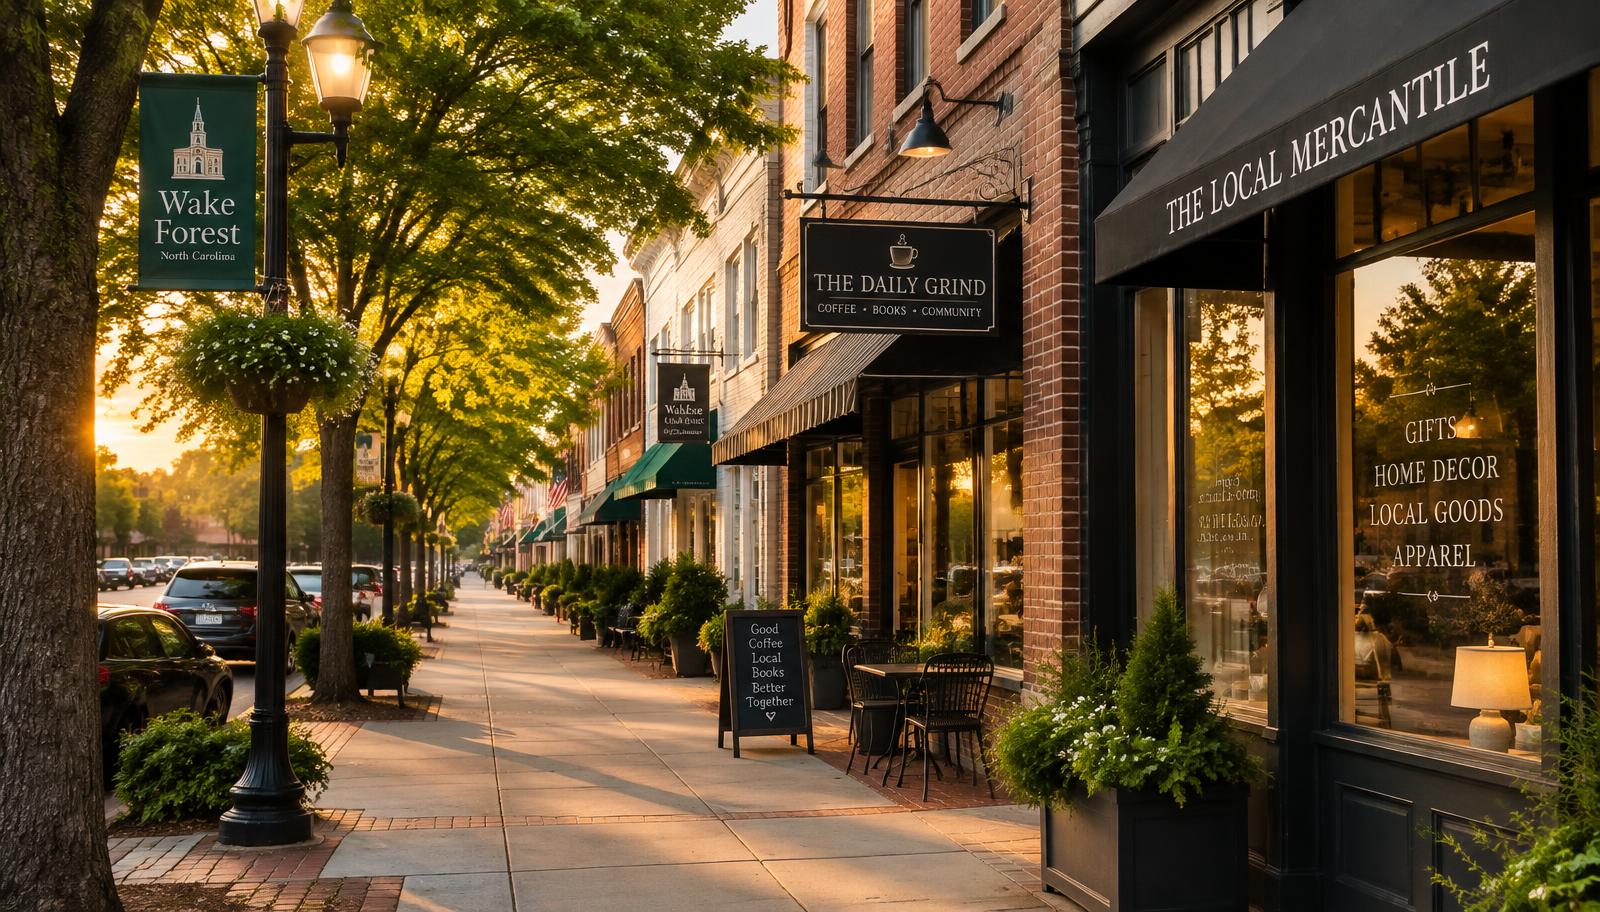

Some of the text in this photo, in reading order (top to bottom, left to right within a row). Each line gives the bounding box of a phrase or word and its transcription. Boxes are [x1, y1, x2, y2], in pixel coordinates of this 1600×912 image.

[1166, 40, 1490, 235] THE LOCAL MERCANTILE
[158, 190, 235, 216] Wake
[154, 219, 241, 245] Forest
[160, 251, 189, 261] North
[813, 273, 986, 296] THE DAILY GRIND
[817, 303, 982, 317] COFFEE BOOKS COMMUNITY
[1405, 415, 1457, 444] GIFTS
[1374, 455, 1500, 487] HOME DECOR
[1370, 498, 1504, 526] LOCAL GOODS
[1392, 544, 1476, 567] APPAREL
[750, 623, 779, 635] Good
[748, 638, 783, 649] Coffee
[752, 652, 782, 664] Local
[752, 666, 785, 678] Books
[752, 682, 786, 693] Better
[745, 696, 794, 710] Together
